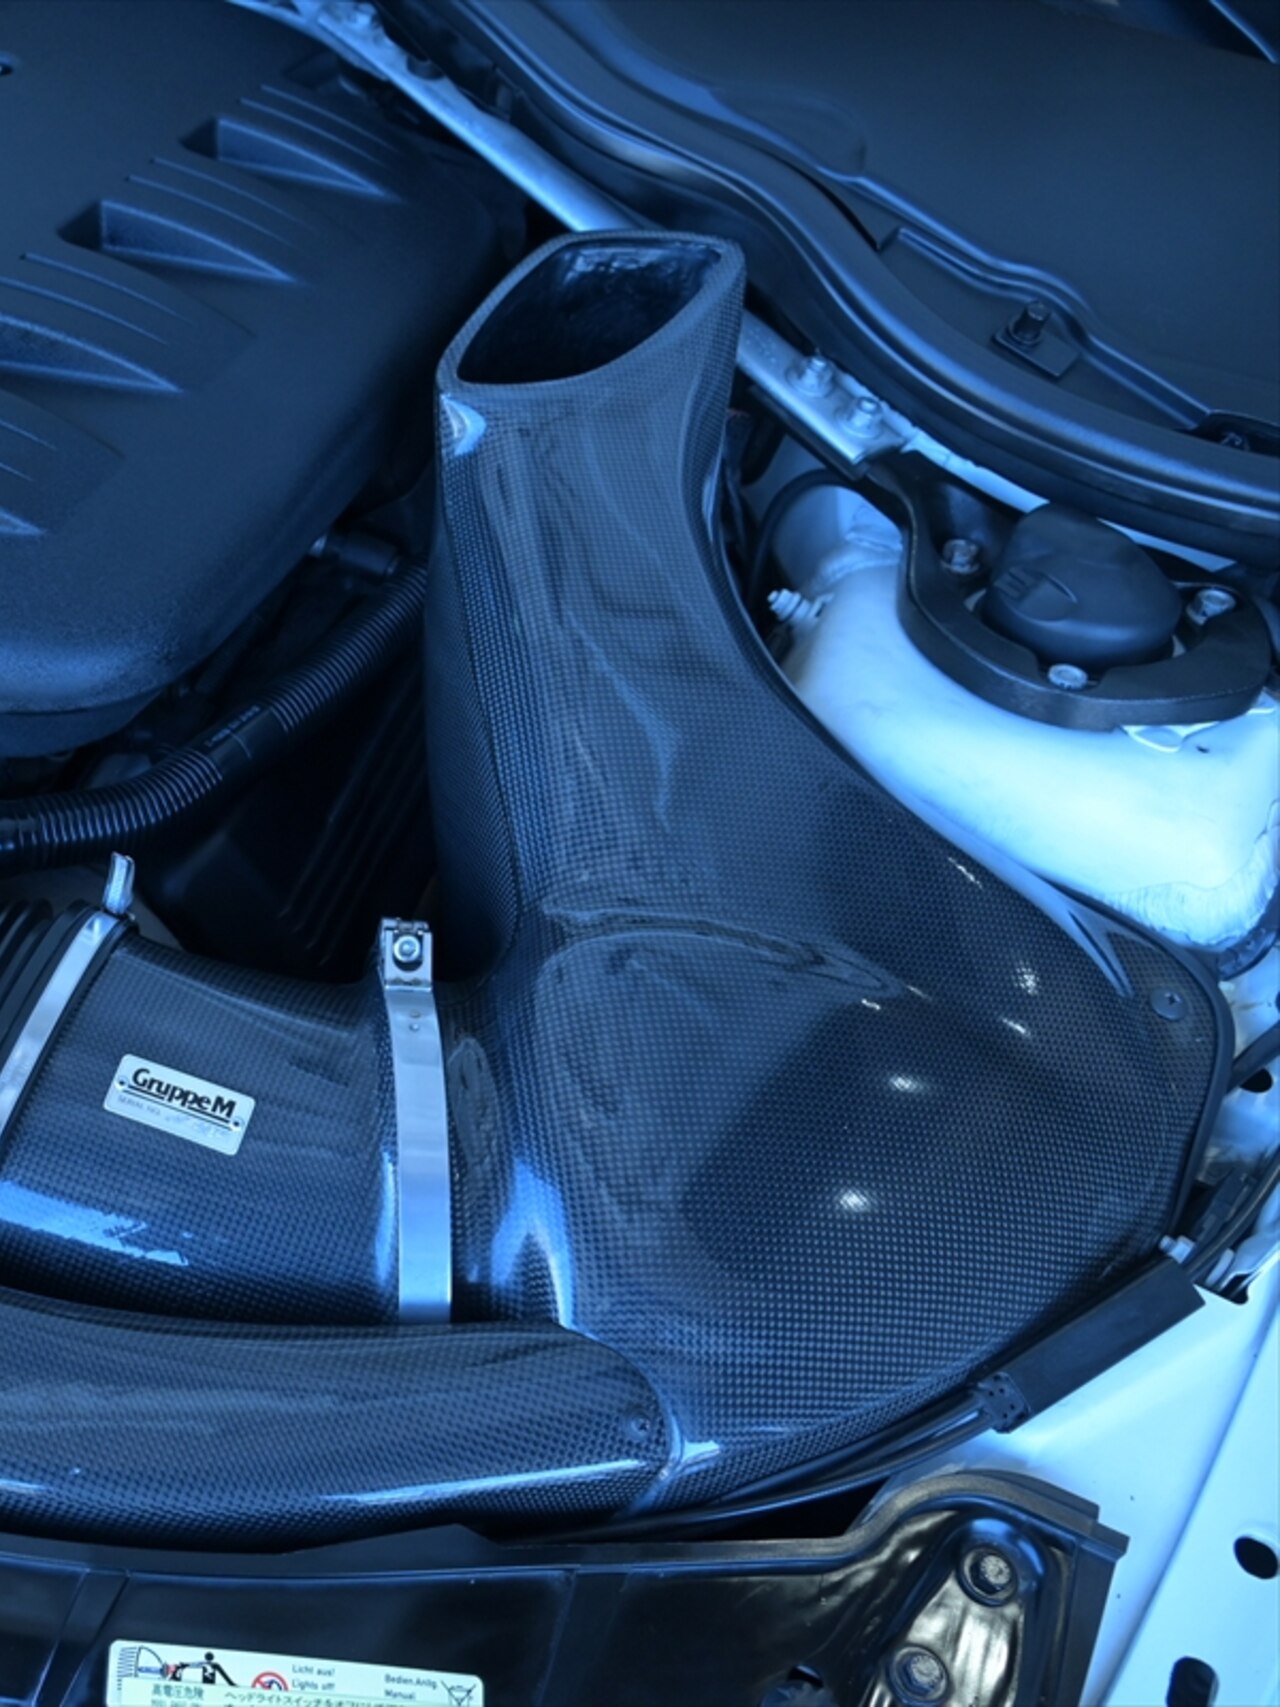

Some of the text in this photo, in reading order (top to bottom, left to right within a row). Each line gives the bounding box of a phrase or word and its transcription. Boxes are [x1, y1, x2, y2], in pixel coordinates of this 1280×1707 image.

[131, 1067, 237, 1118] GruppeM
[292, 1664, 314, 1674] Licht
[292, 1679, 319, 1690] Lights
